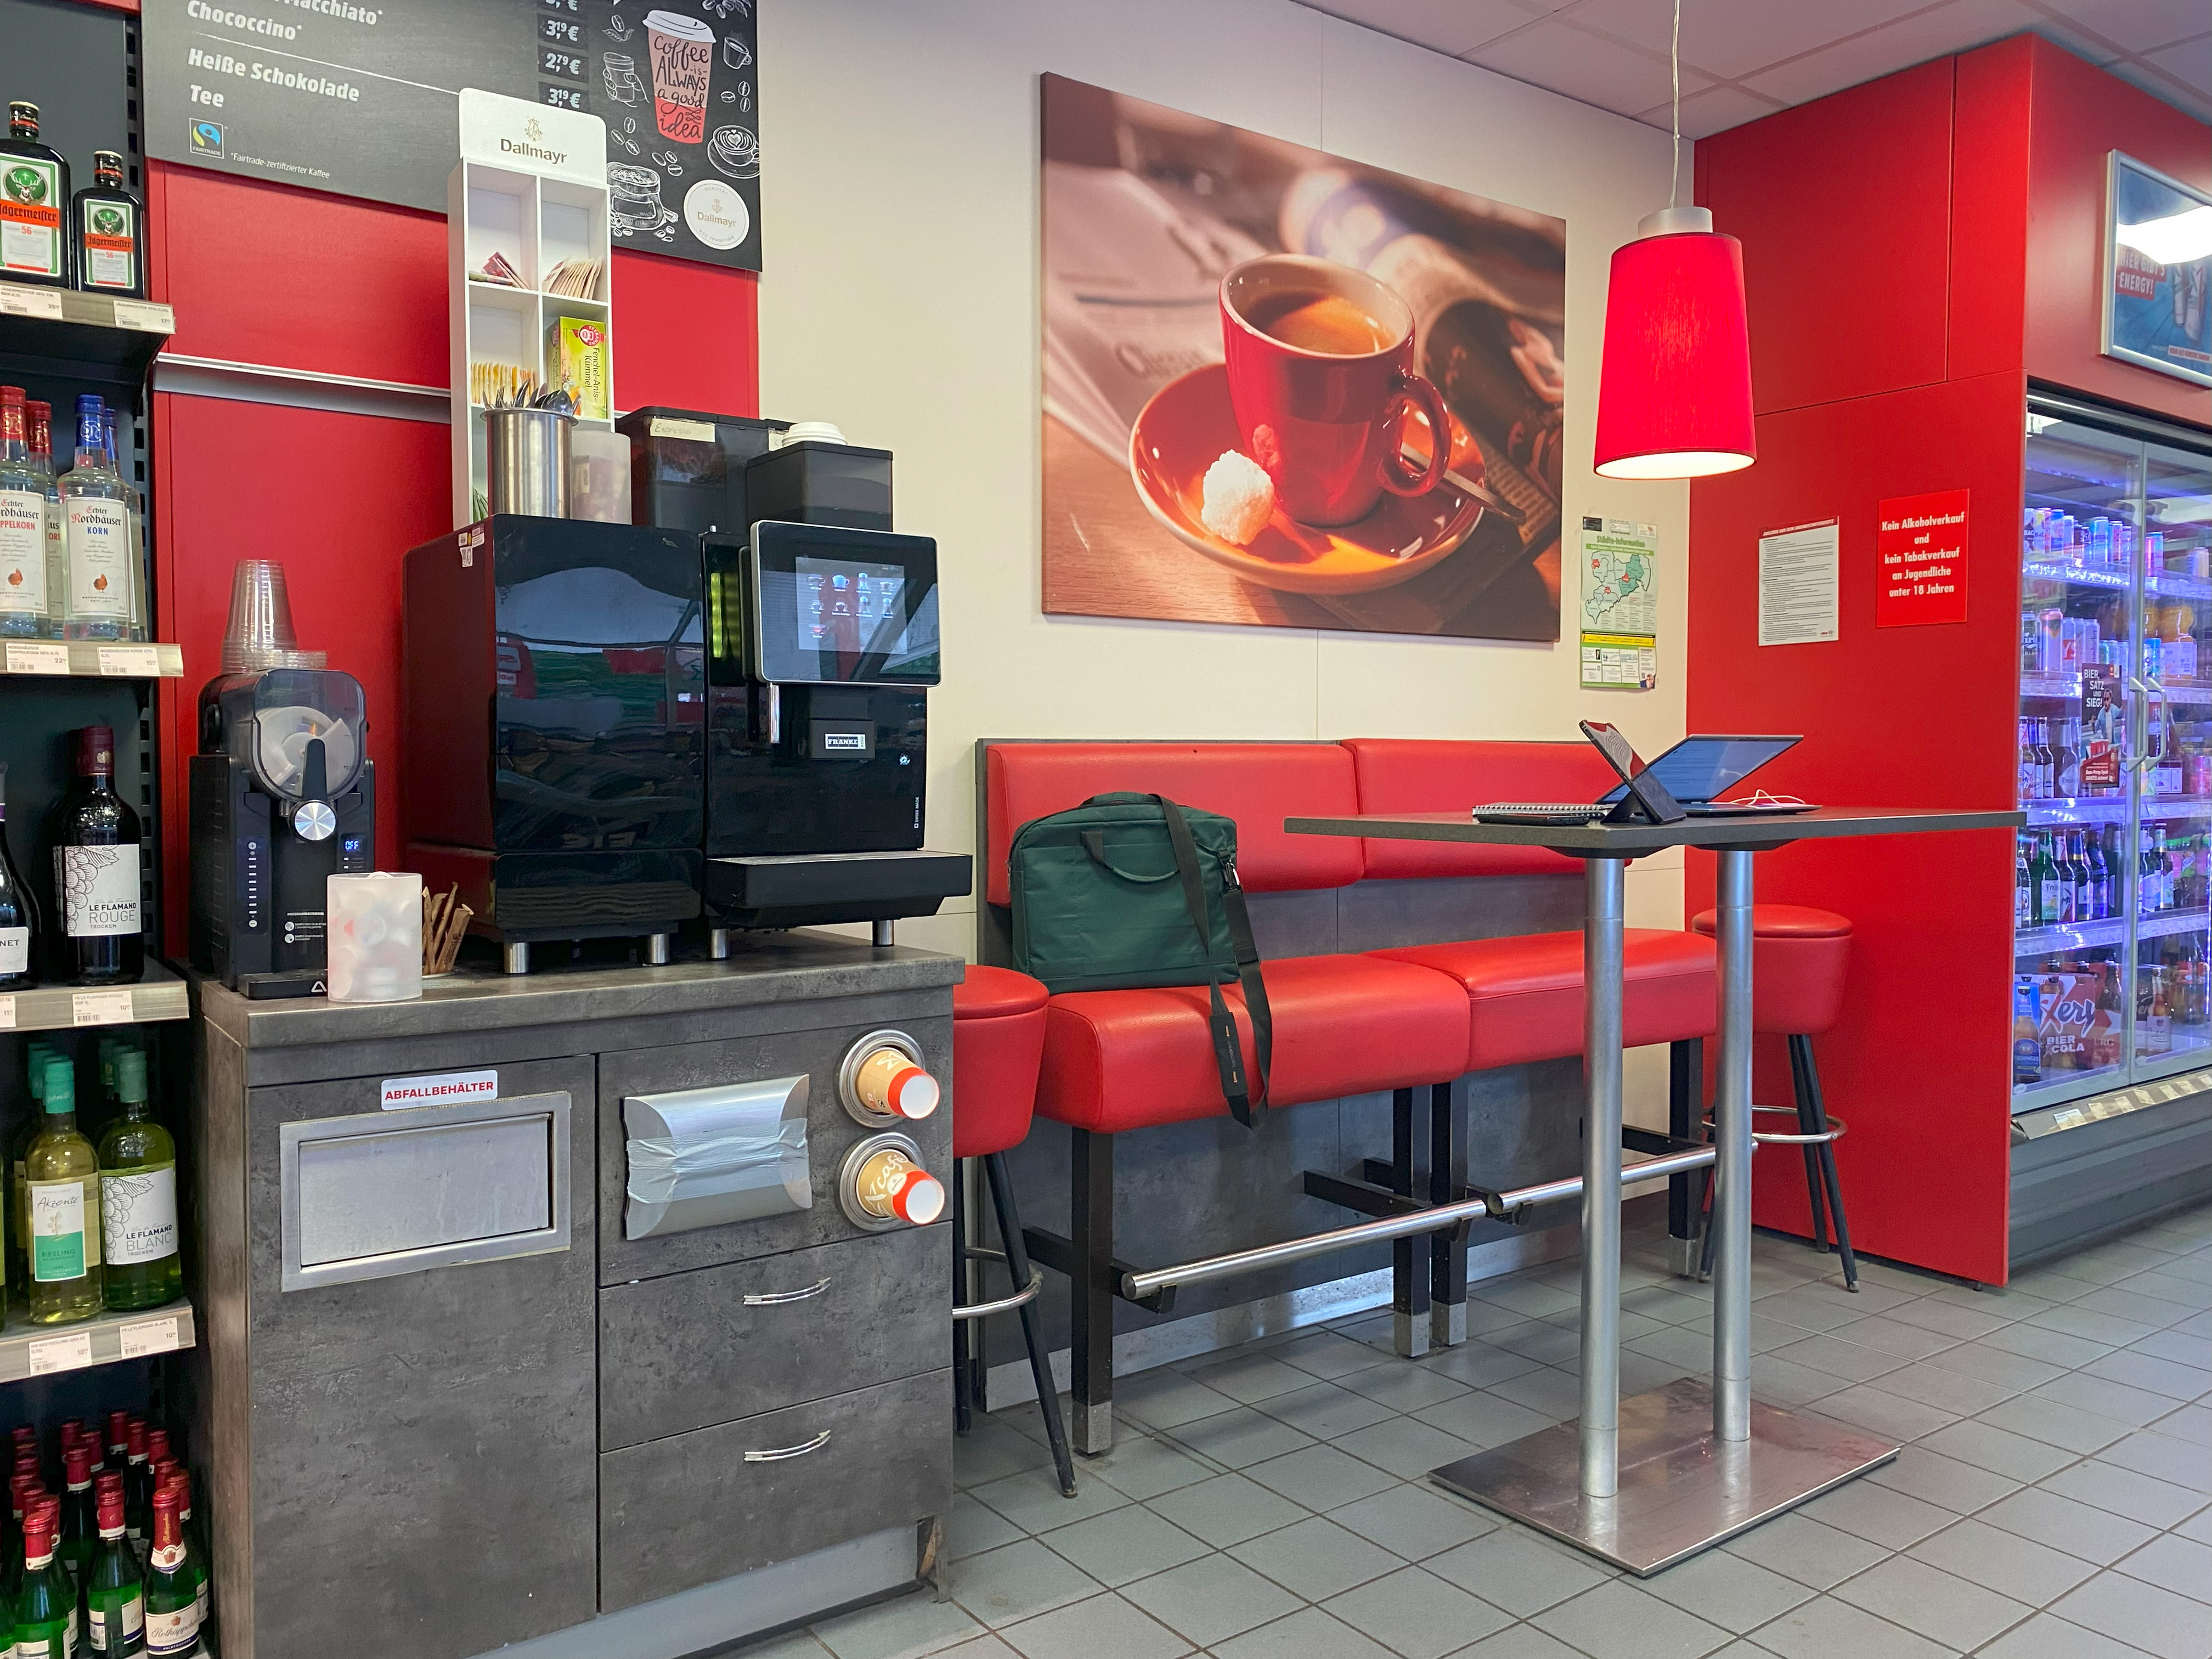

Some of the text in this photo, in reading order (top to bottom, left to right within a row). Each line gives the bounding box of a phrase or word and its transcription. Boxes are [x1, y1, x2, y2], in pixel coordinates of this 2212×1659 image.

[284, 0, 383, 25] acchiato
[188, 48, 360, 102] Heiße Schokolade
[656, 55, 707, 97] ALWAYS
[190, 84, 224, 108] Tee
[657, 89, 705, 114] a good
[659, 112, 701, 138] idea
[192, 146, 222, 156] FAIRTRADE
[500, 138, 567, 165] Dallmayr
[308, 167, 330, 179] Kaffee
[697, 212, 737, 228] Dallmayr
[21, 225, 32, 235] 56
[2119, 272, 2154, 295] ENERGY!
[584, 356, 593, 388] Kümmel
[654, 422, 691, 435] Espresso
[1, 499, 24, 507] Echter
[86, 506, 108, 515] Echter
[71, 513, 122, 526] Nordhäuser
[1881, 511, 1965, 531] Kein Alkoholverkauf
[87, 527, 109, 535] KORN
[1596, 535, 1645, 548] Städte-Information
[1914, 533, 1930, 544] und
[1884, 546, 1961, 565] kein Tabakverkauf
[1892, 565, 1951, 582] an Jugendliche
[1889, 583, 1955, 597] unter 18 Jahren
[2084, 669, 2101, 680] BIER,
[2090, 680, 2105, 690] SATZ
[2086, 697, 2103, 708] SIEG!
[345, 840, 358, 850] OFF
[101, 902, 137, 911] FLAMAND
[89, 910, 136, 923] ROUGE
[2047, 1035, 2076, 1045] BIER
[385, 1081, 494, 1101] ABFALLBEHÄLTER
[37, 1195, 81, 1212] Akzente
[138, 1224, 172, 1238] FLAMAND
[126, 1232, 172, 1251] BLANC
[41, 1248, 75, 1257] RIESLING
[127, 1249, 154, 1257] TROCKEN
